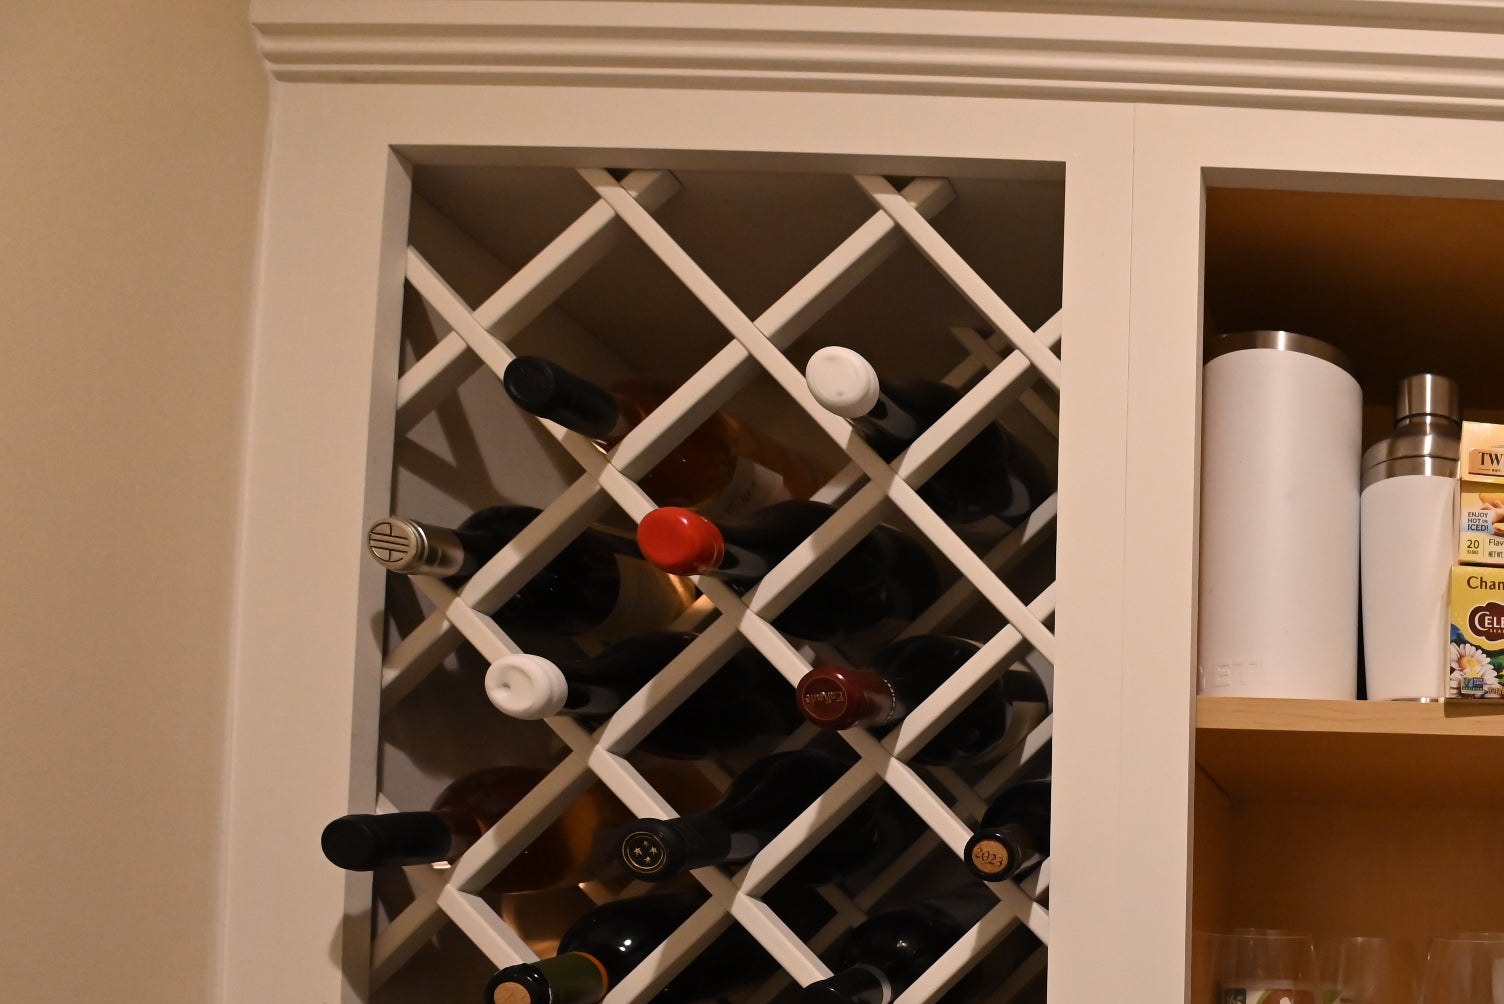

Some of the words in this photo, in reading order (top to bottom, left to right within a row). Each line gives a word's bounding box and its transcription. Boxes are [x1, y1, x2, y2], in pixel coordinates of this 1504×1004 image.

[1467, 524, 1489, 532] ICED!
[1466, 539, 1480, 550] 20
[1488, 550, 1497, 558] NET
[974, 847, 1004, 868] 2023
